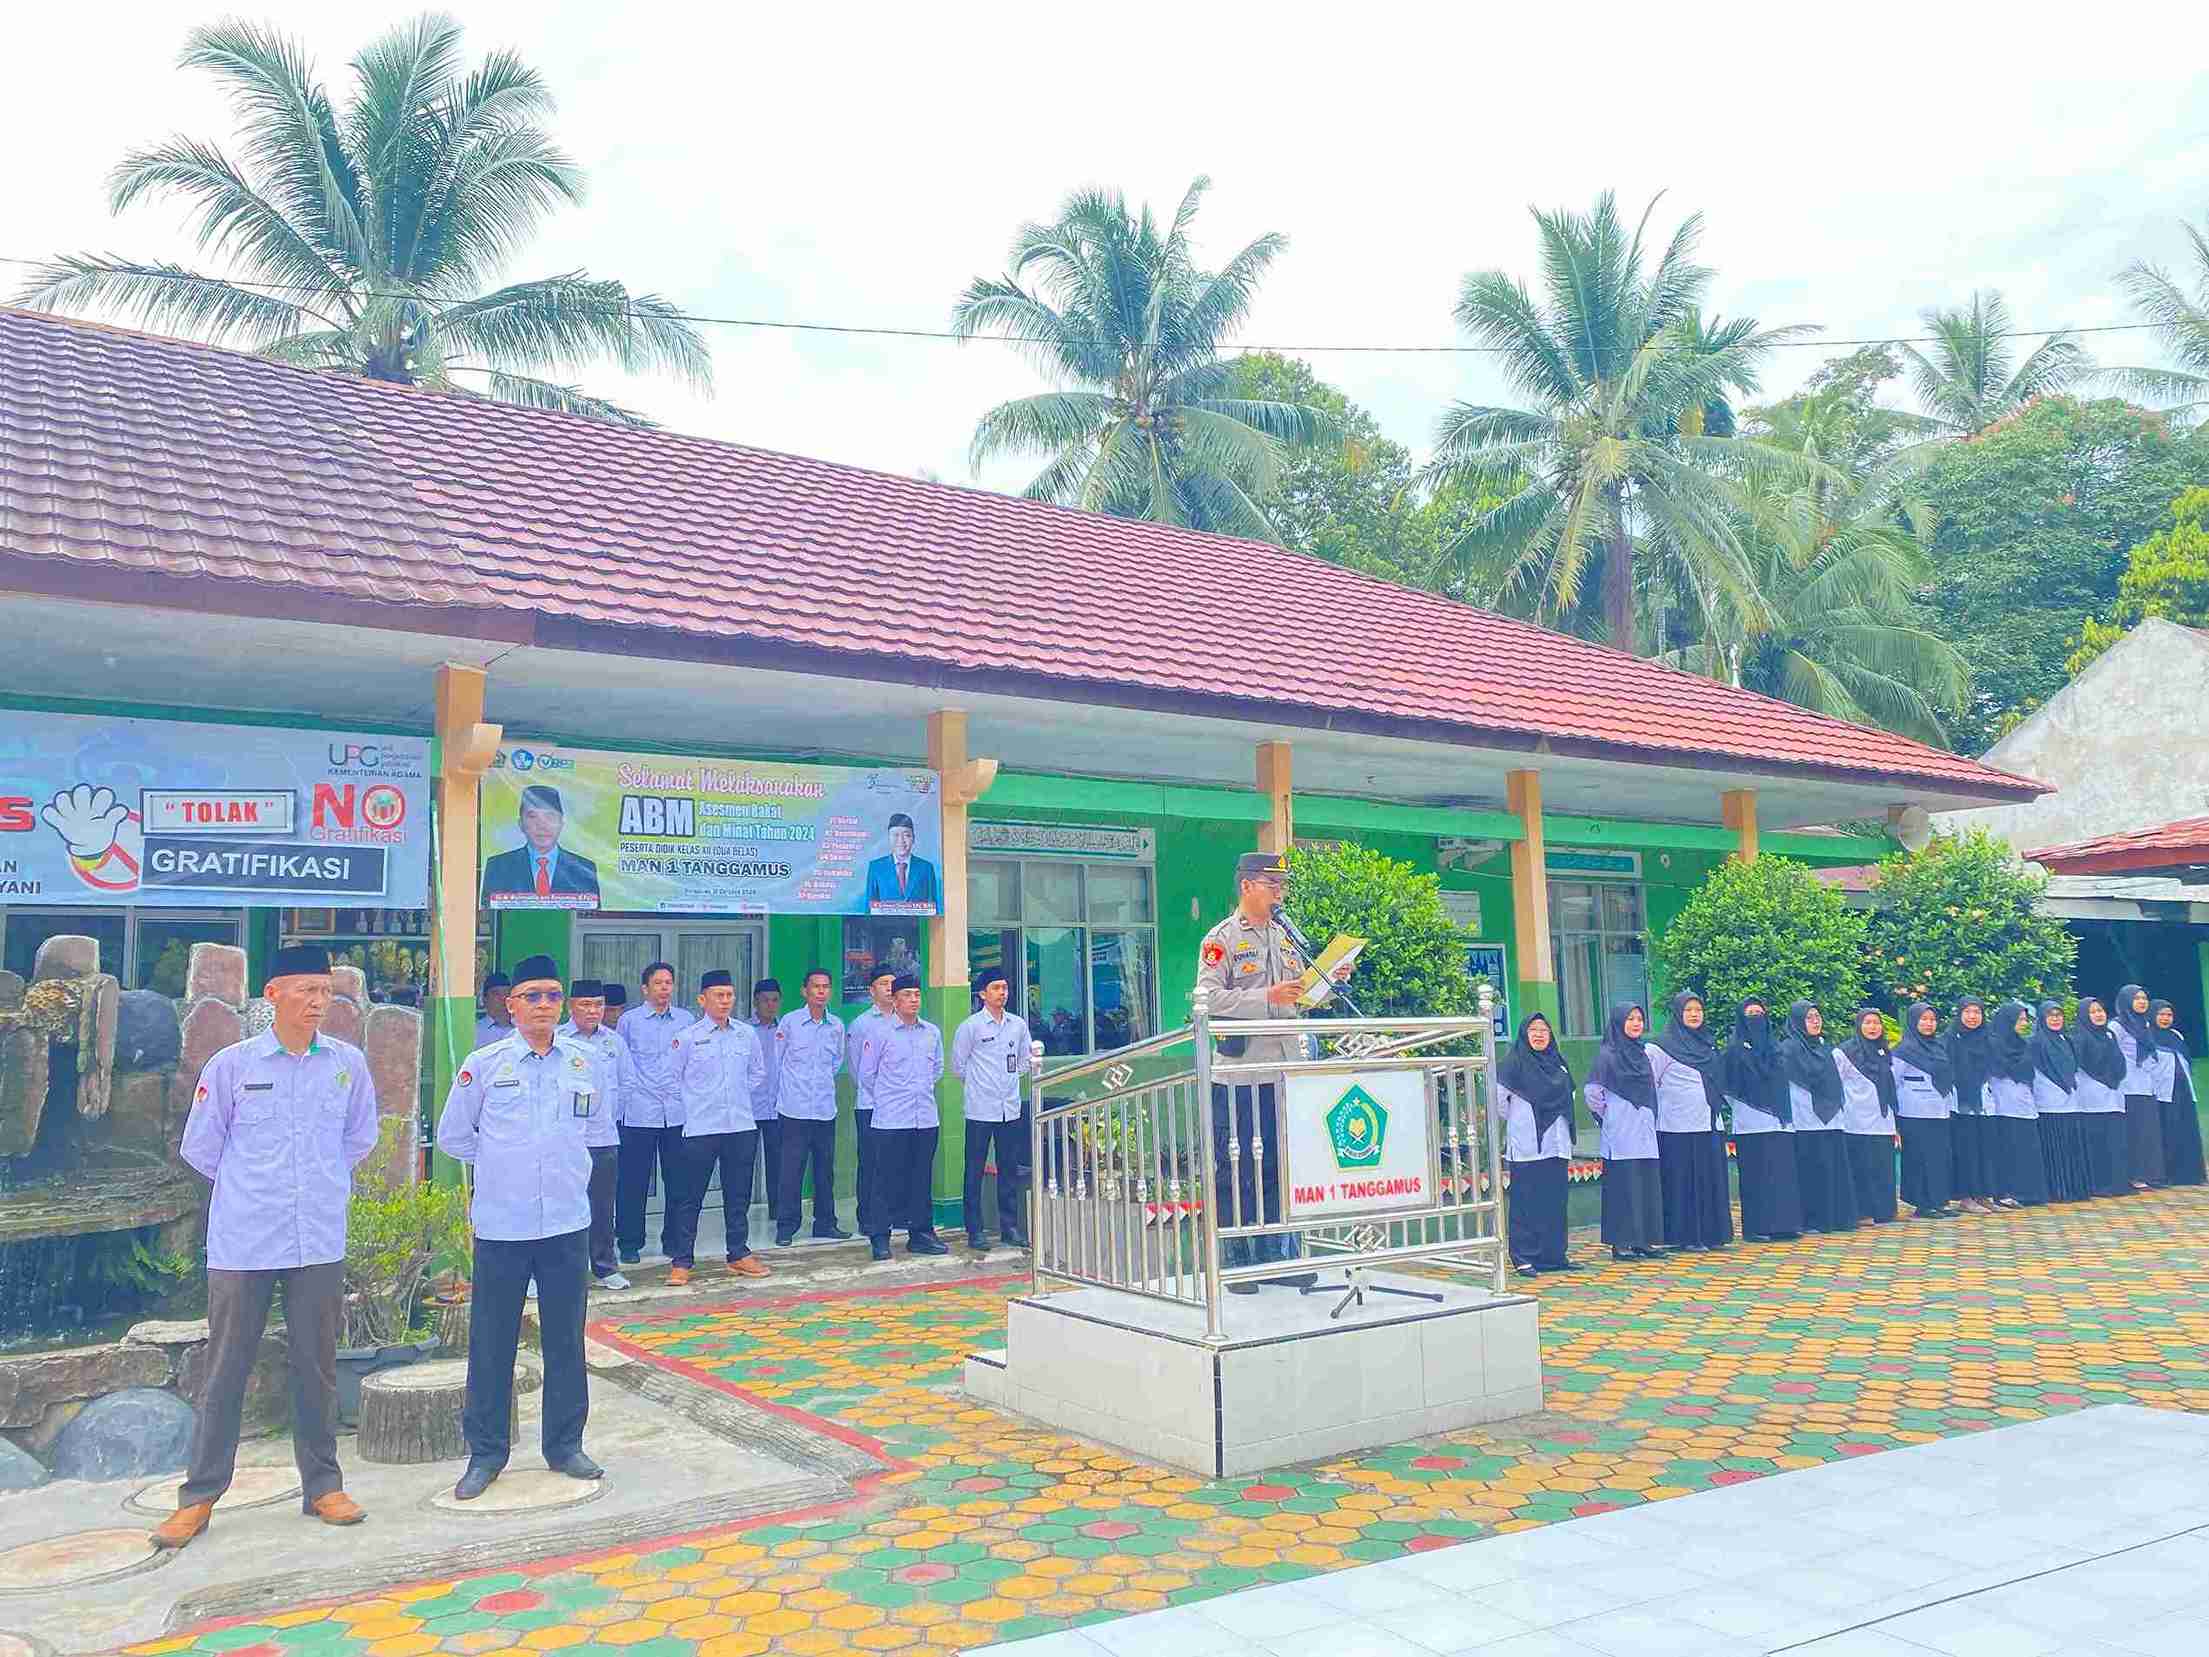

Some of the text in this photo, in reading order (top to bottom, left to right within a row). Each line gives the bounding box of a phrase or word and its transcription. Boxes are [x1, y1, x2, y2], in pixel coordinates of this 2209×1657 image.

[327, 768, 422, 779] KEMENTERIAN AGAMA
[617, 762, 825, 799] Selamat Melaksanakan
[619, 795, 695, 838] ABM
[311, 826, 408, 844] Gratifikasi
[755, 824, 787, 841] Tahun
[789, 825, 816, 842] 2024
[620, 843, 652, 854] PESERTA
[655, 844, 676, 855] DIDIK
[678, 844, 700, 856] KELAS
[151, 848, 351, 881] GRATIFIKASI
[620, 859, 791, 879] MAN 1 TANGGAMUS
[1294, 1176, 1422, 1205] MAN 1 TANGGAMUS
